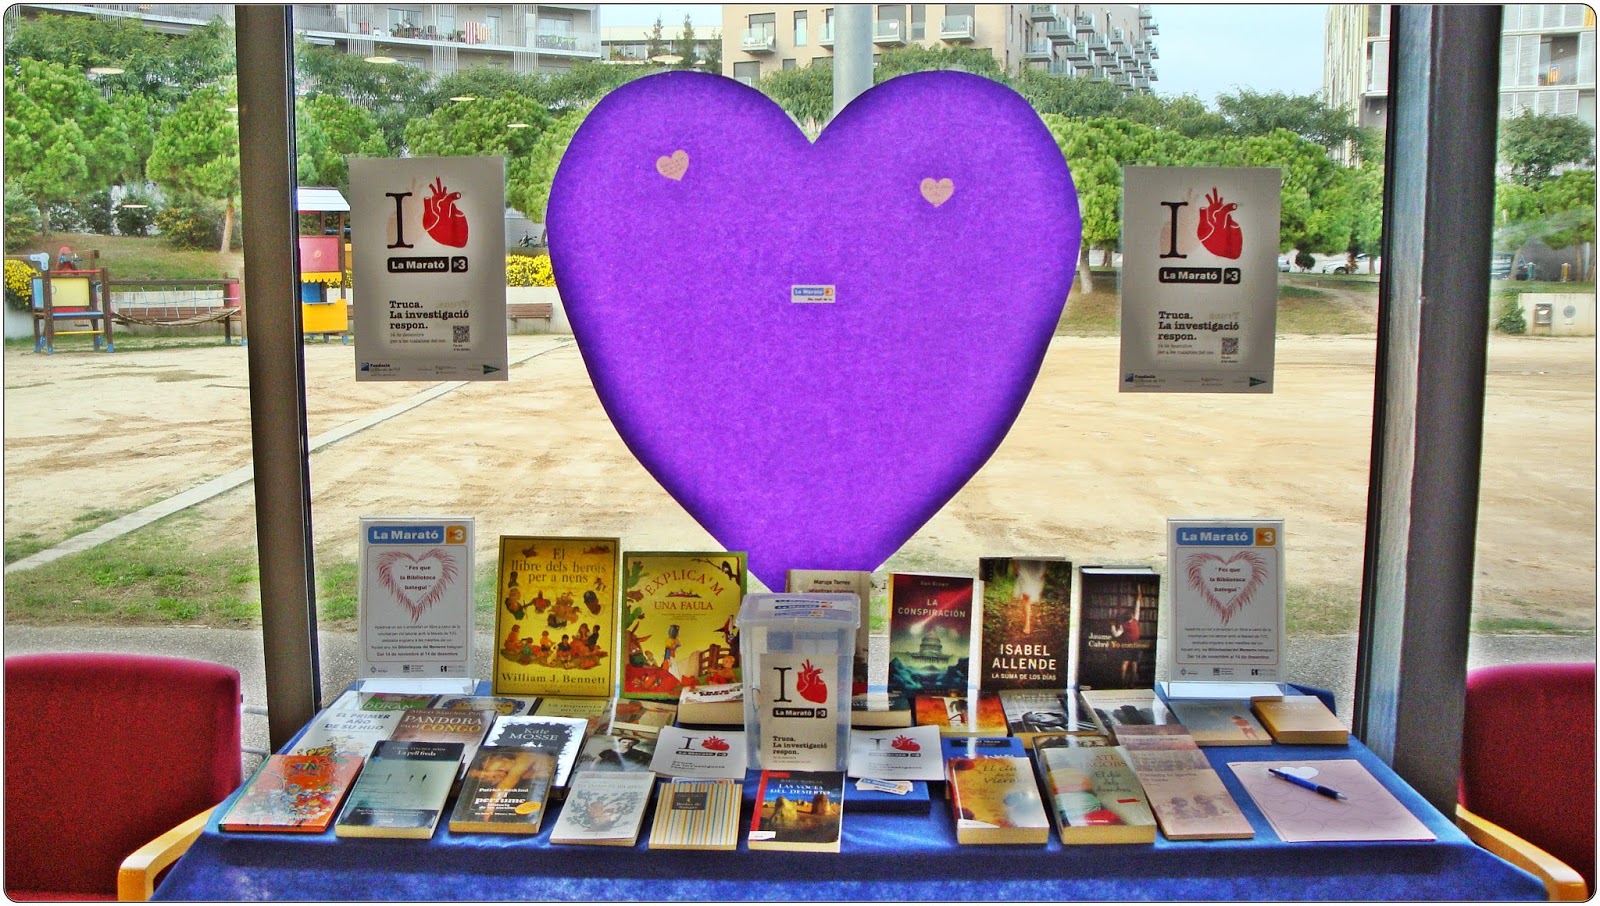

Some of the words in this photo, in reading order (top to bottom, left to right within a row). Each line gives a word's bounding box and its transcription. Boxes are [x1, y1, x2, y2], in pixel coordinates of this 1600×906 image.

[386, 192, 414, 249] I
[1159, 201, 1188, 259] I
[392, 260, 404, 270] La
[406, 259, 446, 270] Marató
[1164, 270, 1176, 280] La
[1178, 270, 1218, 281] Marató
[389, 300, 424, 308] Truca.
[389, 310, 403, 319] La
[405, 310, 470, 320] investigació
[1158, 310, 1194, 320] Truca.
[390, 322, 428, 331] respon.
[1158, 321, 1172, 330] La
[1174, 320, 1240, 332] investigació
[1158, 333, 1198, 342] respon.
[373, 530, 388, 540] La
[391, 529, 440, 540] Marató
[454, 529, 464, 540] 3
[1182, 532, 1198, 542] La
[1200, 531, 1248, 542] Marató
[1264, 532, 1274, 542] 3
[553, 548, 565, 560] El
[511, 560, 542, 572] llibre
[546, 561, 568, 572] dels
[573, 561, 607, 573] herois
[528, 573, 547, 584] per
[550, 574, 557, 582] a
[562, 574, 588, 583] nens
[644, 570, 724, 596] EXPLICA'M
[654, 601, 677, 610] UNA
[680, 601, 714, 610] FAULA
[926, 598, 938, 606] LA
[898, 607, 966, 618] CONSPIRACIÓN
[1088, 632, 1112, 640] Jaume
[1110, 640, 1120, 648] Yo
[1000, 644, 1050, 656] ISABEL
[992, 657, 1057, 670] ALLENDE
[501, 672, 546, 682] William
[550, 674, 560, 683] J.
[563, 674, 606, 684] Bennett
[772, 667, 792, 703] I
[404, 715, 482, 726] PANDORA
[420, 724, 481, 732] CONGO
[509, 732, 559, 741] MOSSE
[783, 742, 828, 750] investigació
